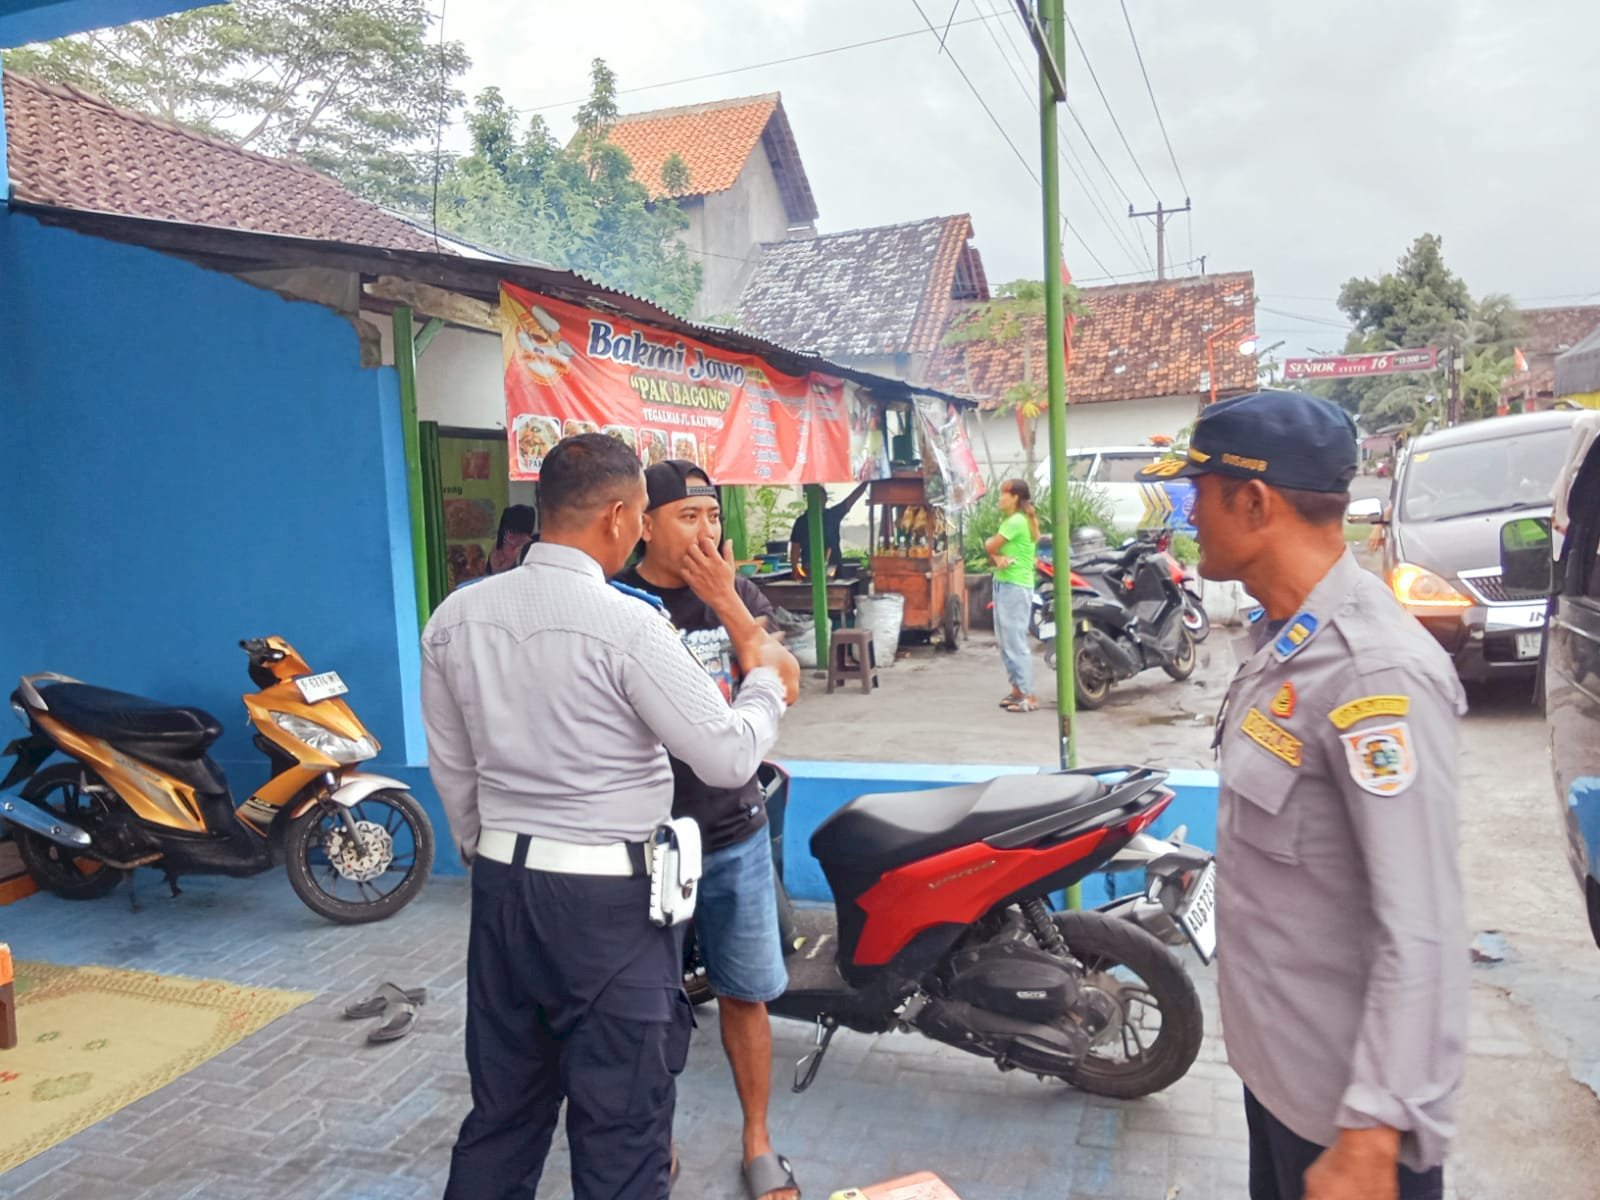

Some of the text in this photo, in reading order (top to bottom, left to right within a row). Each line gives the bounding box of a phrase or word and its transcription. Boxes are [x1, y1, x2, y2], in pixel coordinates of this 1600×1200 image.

[588, 320, 746, 386] Bakmi Jowo
[1371, 357, 1388, 369] 16
